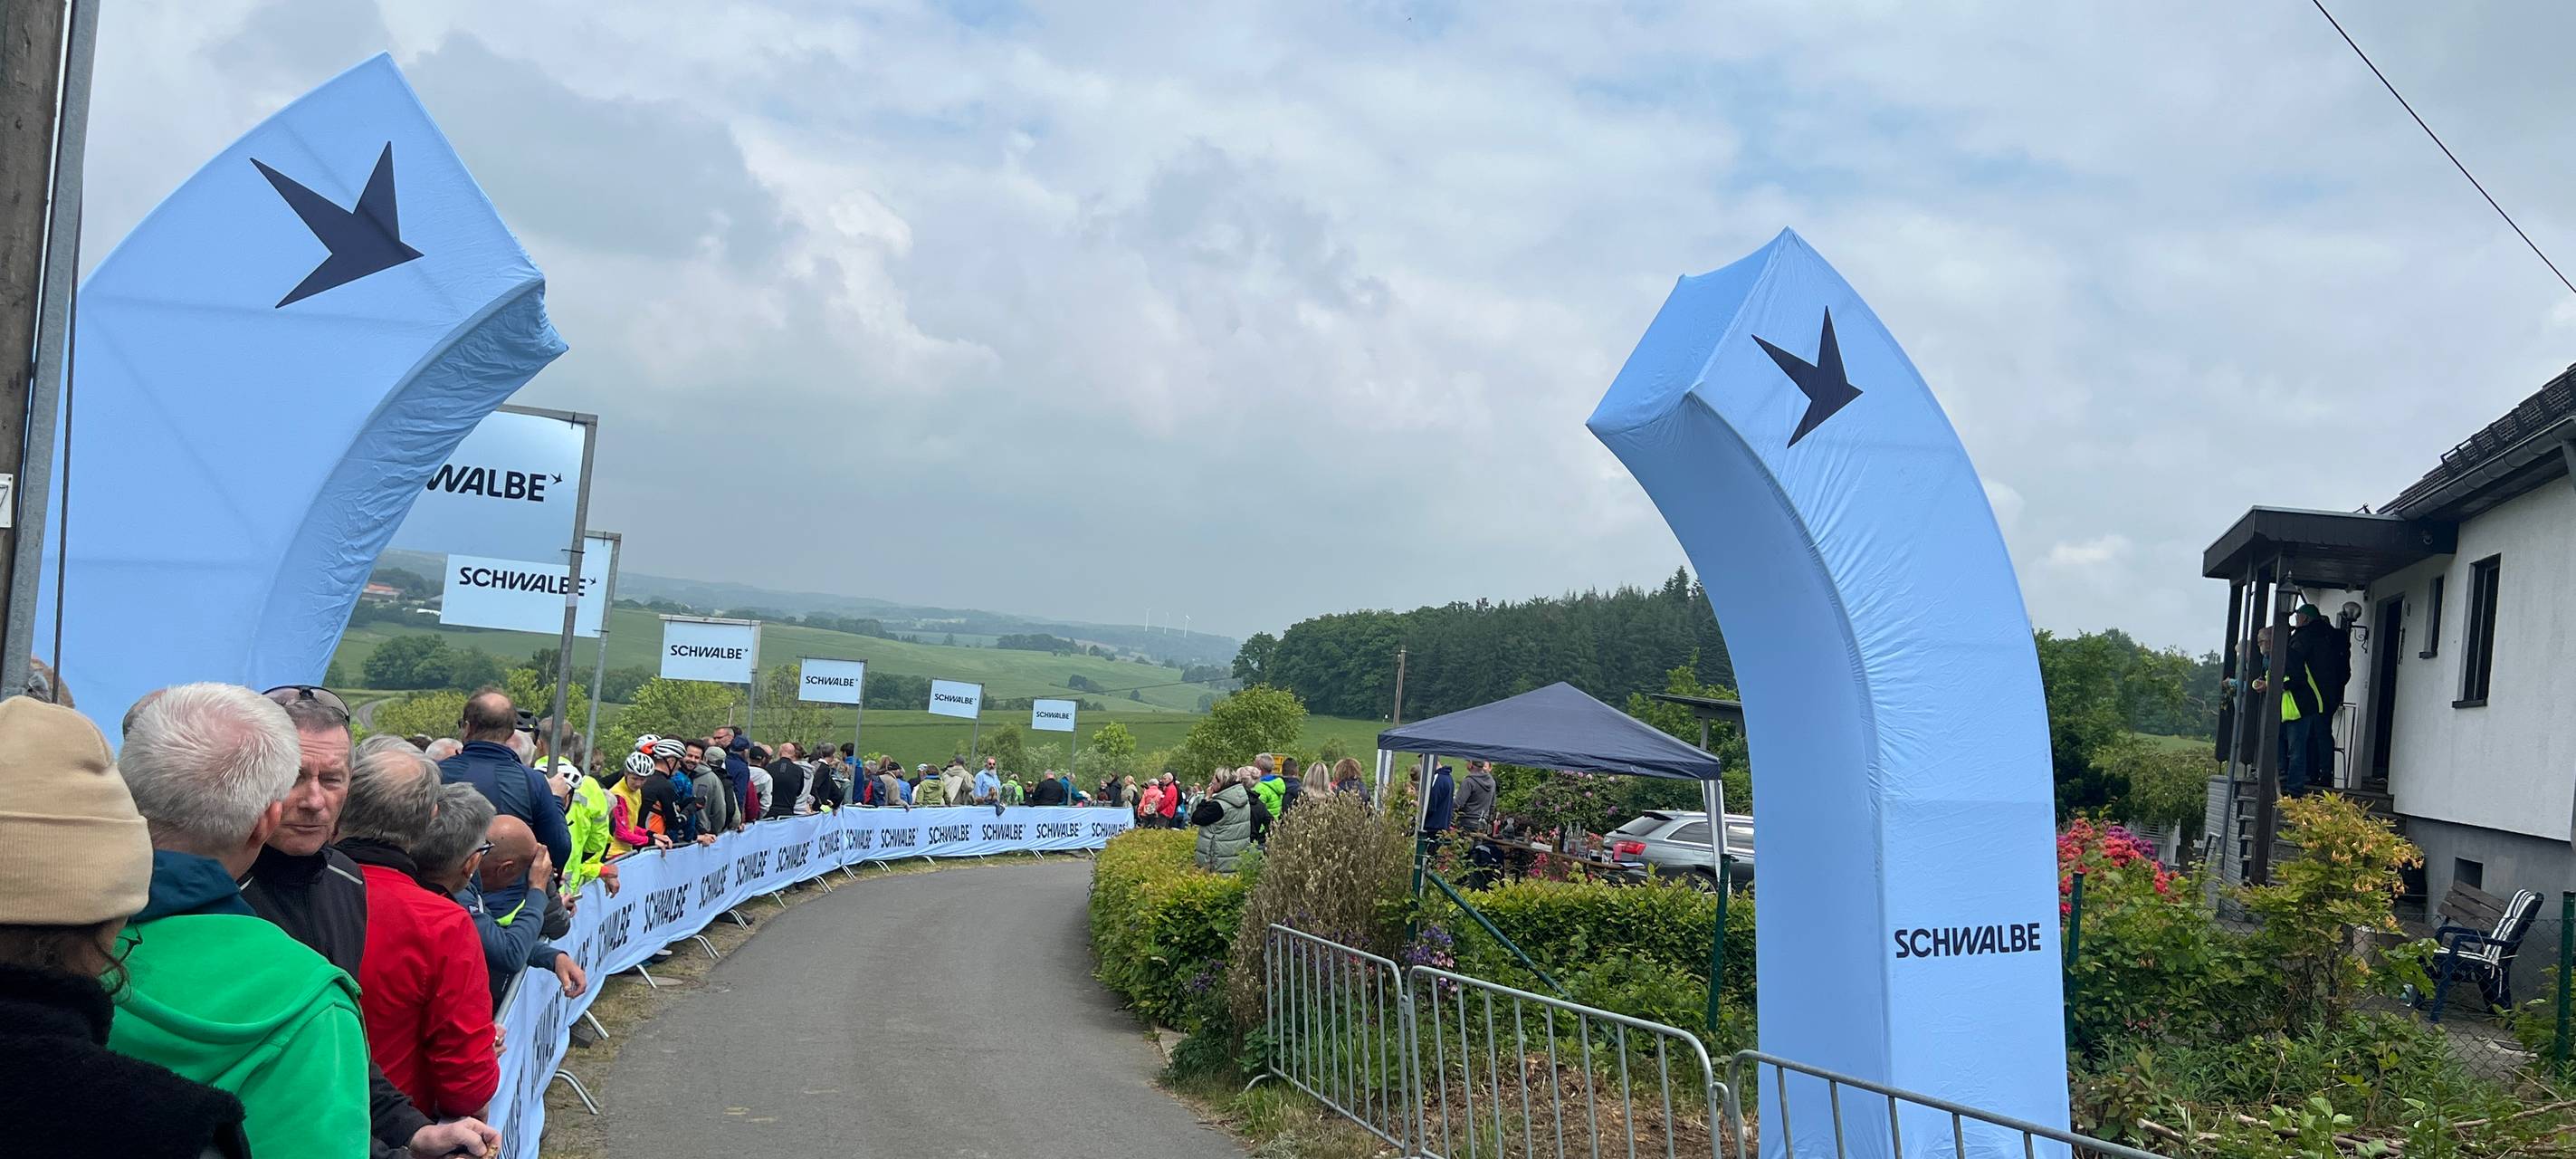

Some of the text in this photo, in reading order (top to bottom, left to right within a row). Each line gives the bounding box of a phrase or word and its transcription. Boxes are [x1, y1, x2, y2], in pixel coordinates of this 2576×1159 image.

[426, 464, 547, 503] WALBE
[459, 567, 587, 597] SCHWALBE
[671, 645, 742, 659] SCHWALBE
[806, 675, 854, 686] SCHWALBE
[934, 693, 973, 705] SCHWALBE
[1035, 711, 1070, 720] SCHWALBE
[881, 828, 916, 848] SCHWALBE
[929, 824, 969, 845] SCHWALBE
[982, 824, 1023, 840] SCHWALBE
[1036, 822, 1079, 838] SCHWALBE
[1894, 923, 2041, 958] SCHWALBE
